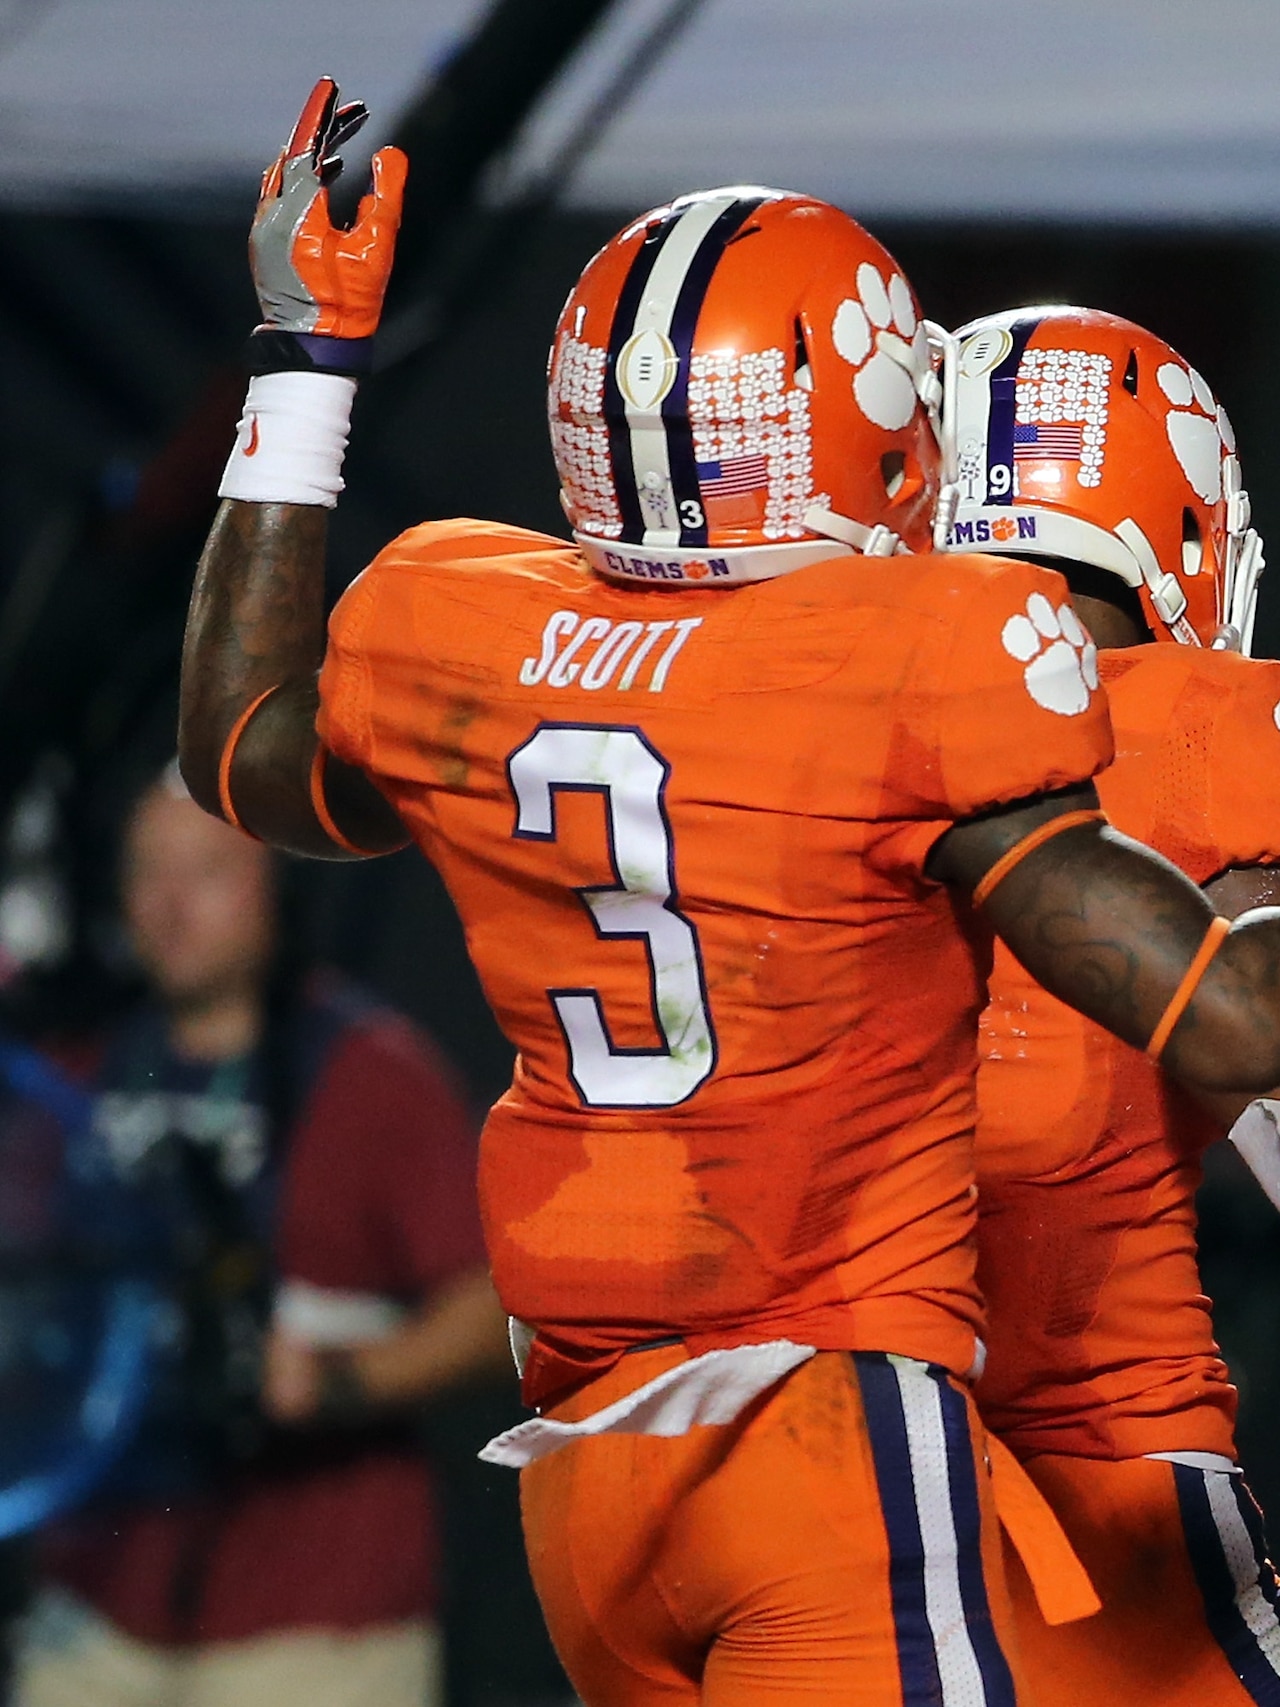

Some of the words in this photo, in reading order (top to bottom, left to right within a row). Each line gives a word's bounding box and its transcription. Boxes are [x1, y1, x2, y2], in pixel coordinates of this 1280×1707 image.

[989, 464, 1011, 496] 9
[680, 499, 705, 529] 3
[518, 609, 703, 693] SCOTT
[504, 720, 719, 1108] 3
